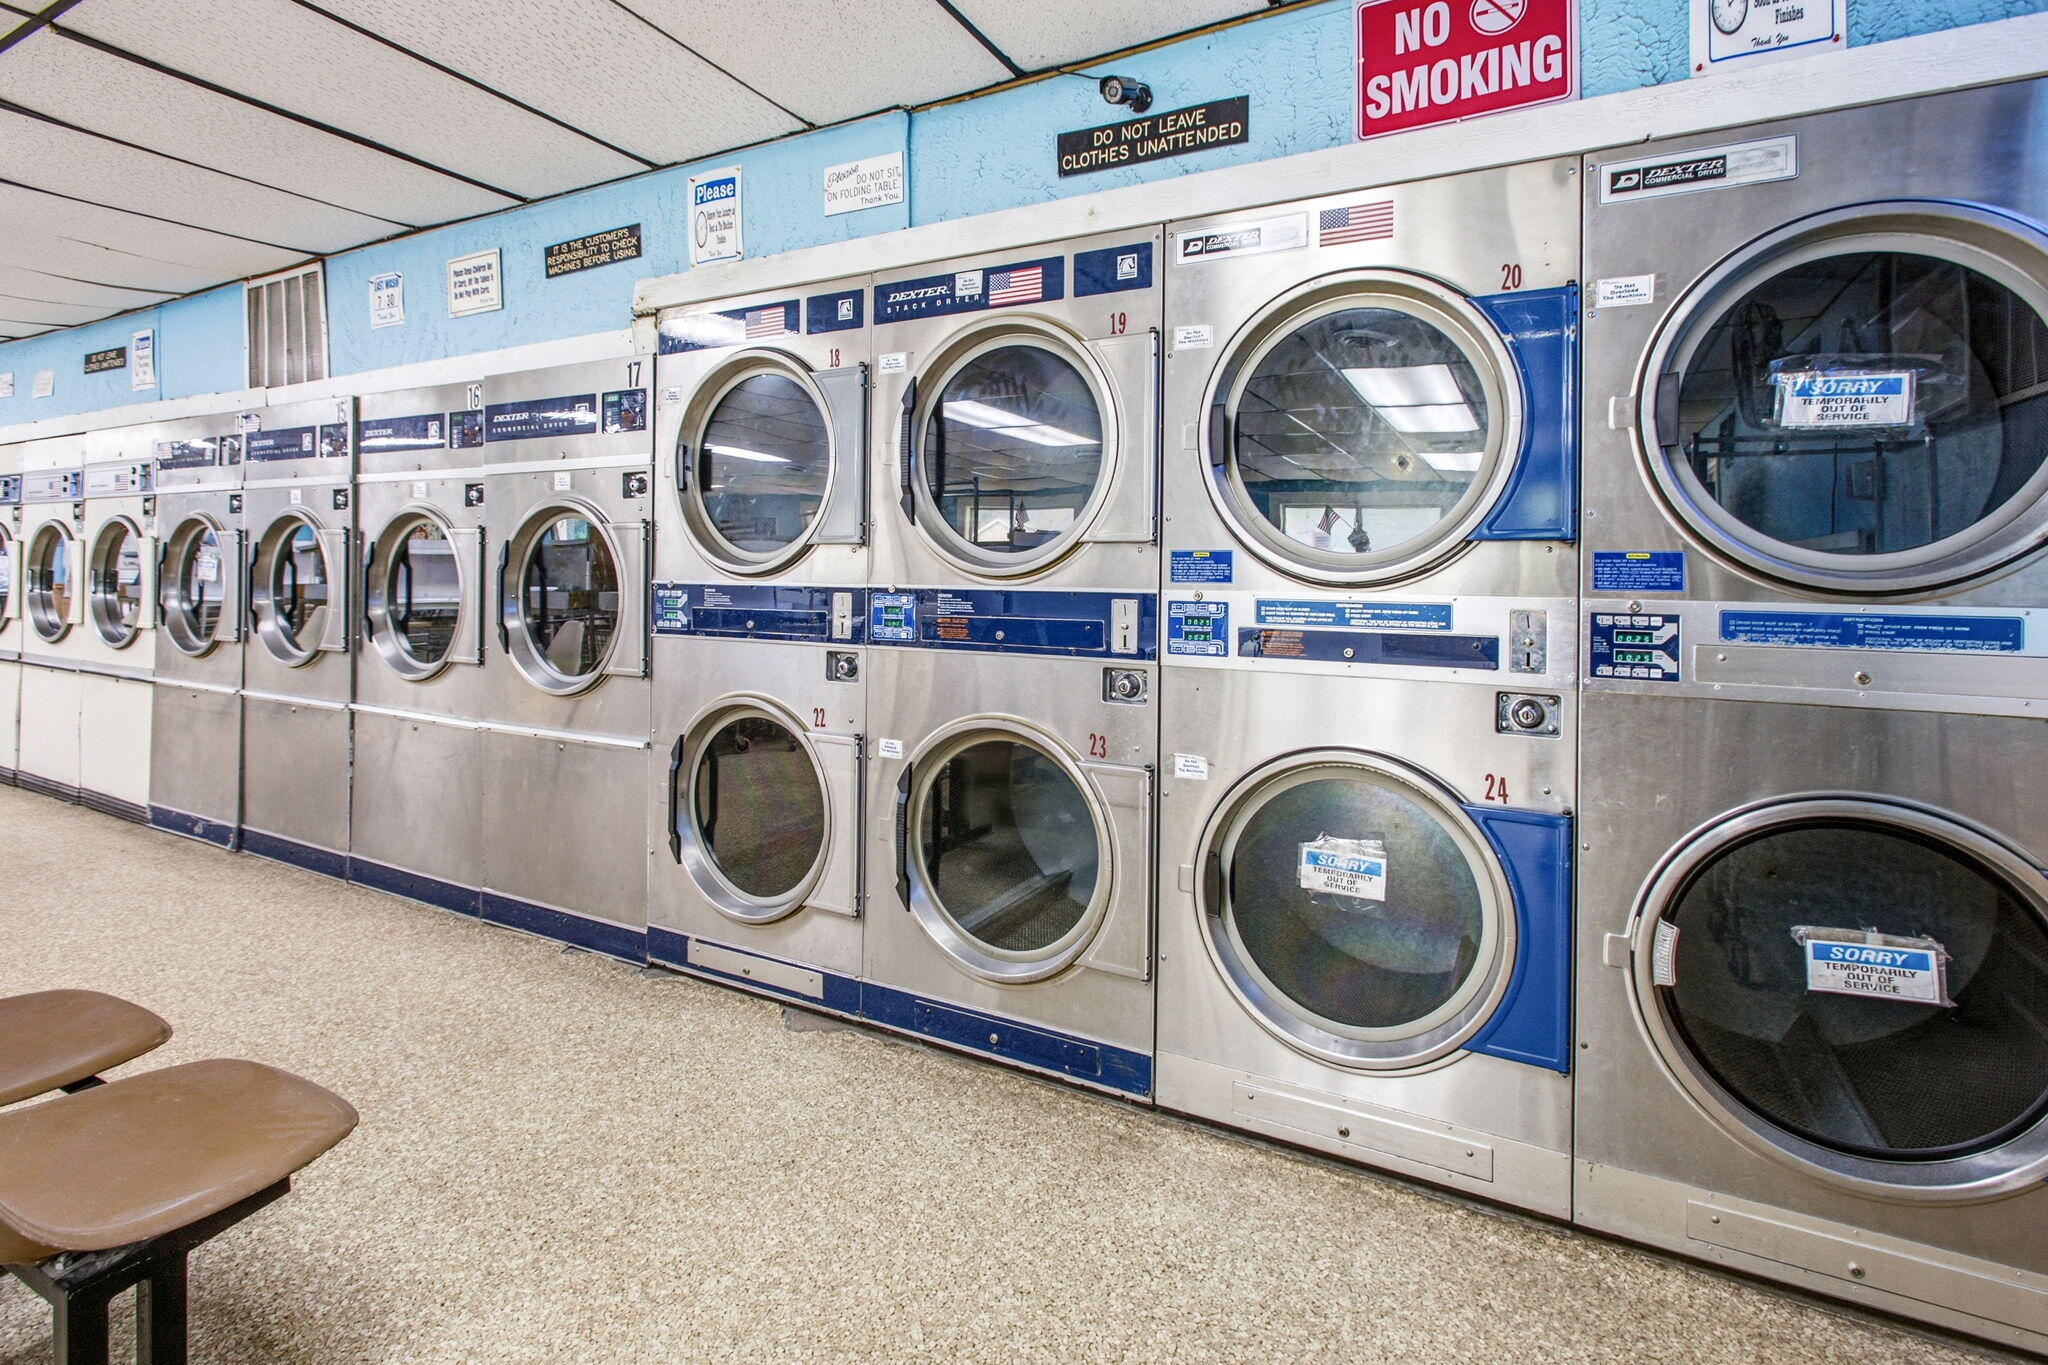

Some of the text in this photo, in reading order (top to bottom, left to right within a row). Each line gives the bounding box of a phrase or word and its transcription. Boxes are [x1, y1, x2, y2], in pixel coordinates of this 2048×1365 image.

[1775, 5, 1804, 25] Finishes
[1395, 1, 1450, 55] NO
[1751, 32, 1789, 48] Thank You
[1366, 34, 1563, 119] SMOKING
[1094, 109, 1206, 147] DO NOT LEAVE
[1062, 122, 1241, 170] CLOTHES UNATTENDED
[827, 164, 859, 188] Please
[856, 173, 867, 185] DO
[869, 169, 885, 181] NOT
[1644, 167, 1724, 185] COMMERCIAL DRYER
[1645, 159, 1724, 179] DEXTER
[696, 183, 734, 204] Please
[827, 192, 838, 202] ON
[840, 184, 871, 199] FOLDING
[861, 195, 882, 205] Thank
[547, 237, 638, 266] RESPONSIBILITY TO CHECK
[553, 245, 560, 254] IT
[561, 243, 568, 252] IS
[570, 241, 583, 250] THE
[548, 259, 581, 275] MACHINES
[583, 253, 611, 267] BEFORE
[1501, 264, 1522, 290] 20
[887, 285, 948, 303] DEXTER
[887, 295, 980, 314] STACK DRYER
[1110, 312, 1126, 335] 19
[829, 348, 841, 368] 18
[627, 361, 642, 388] 17
[469, 386, 481, 409] 16
[1809, 379, 1884, 396] SORRY
[1801, 396, 1889, 406] TEMPORARILY
[1821, 405, 1846, 413] OUT
[492, 412, 529, 422] DEXTER
[1817, 413, 1870, 421] SERVICE
[813, 707, 826, 727] 22
[1089, 733, 1106, 758] 23
[1485, 773, 1509, 804] 24
[1313, 866, 1373, 882] TEMPORARILY
[1327, 875, 1344, 883] OUT
[1324, 882, 1360, 893] SERVICE
[1830, 946, 1909, 966] SORRY
[1824, 962, 1917, 979] TEMPORARILY
[1846, 973, 1896, 984] OUT OF
[1844, 980, 1901, 993] SERVICE
